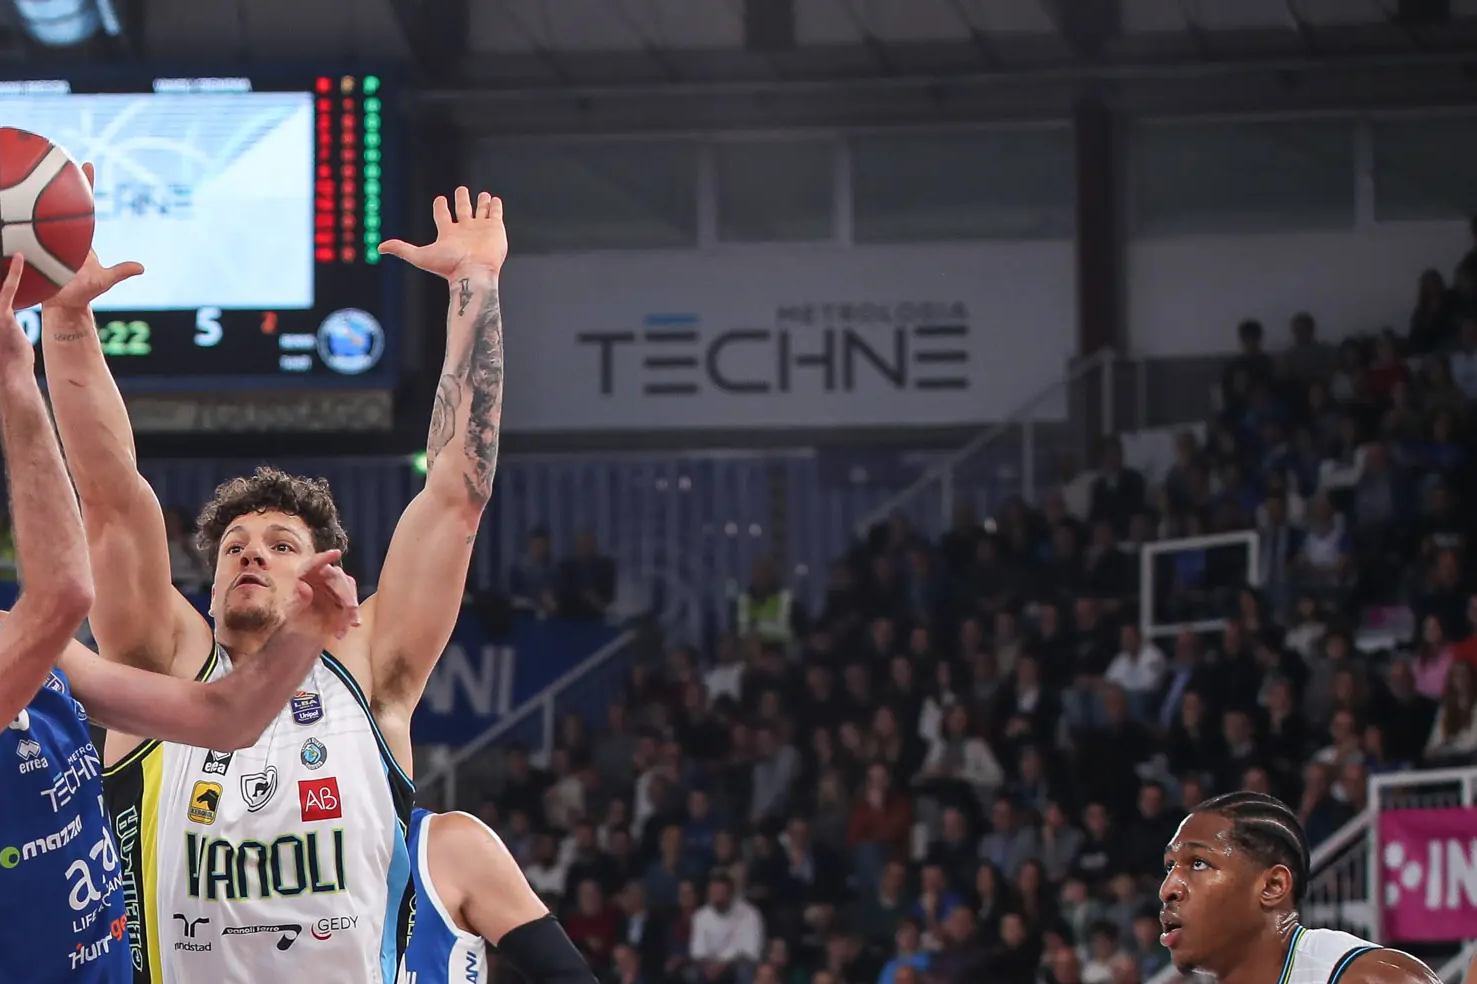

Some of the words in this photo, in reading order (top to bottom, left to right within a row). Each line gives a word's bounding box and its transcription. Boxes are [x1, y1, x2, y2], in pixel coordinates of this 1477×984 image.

[193, 306, 223, 347] 5
[576, 314, 970, 396] TECHNE
[19, 757, 49, 775] errea
[68, 742, 92, 765] METRO
[40, 745, 101, 813] TECHN
[306, 787, 337, 812] AB
[184, 827, 347, 902] VANOLI
[317, 915, 359, 932] GEDY
